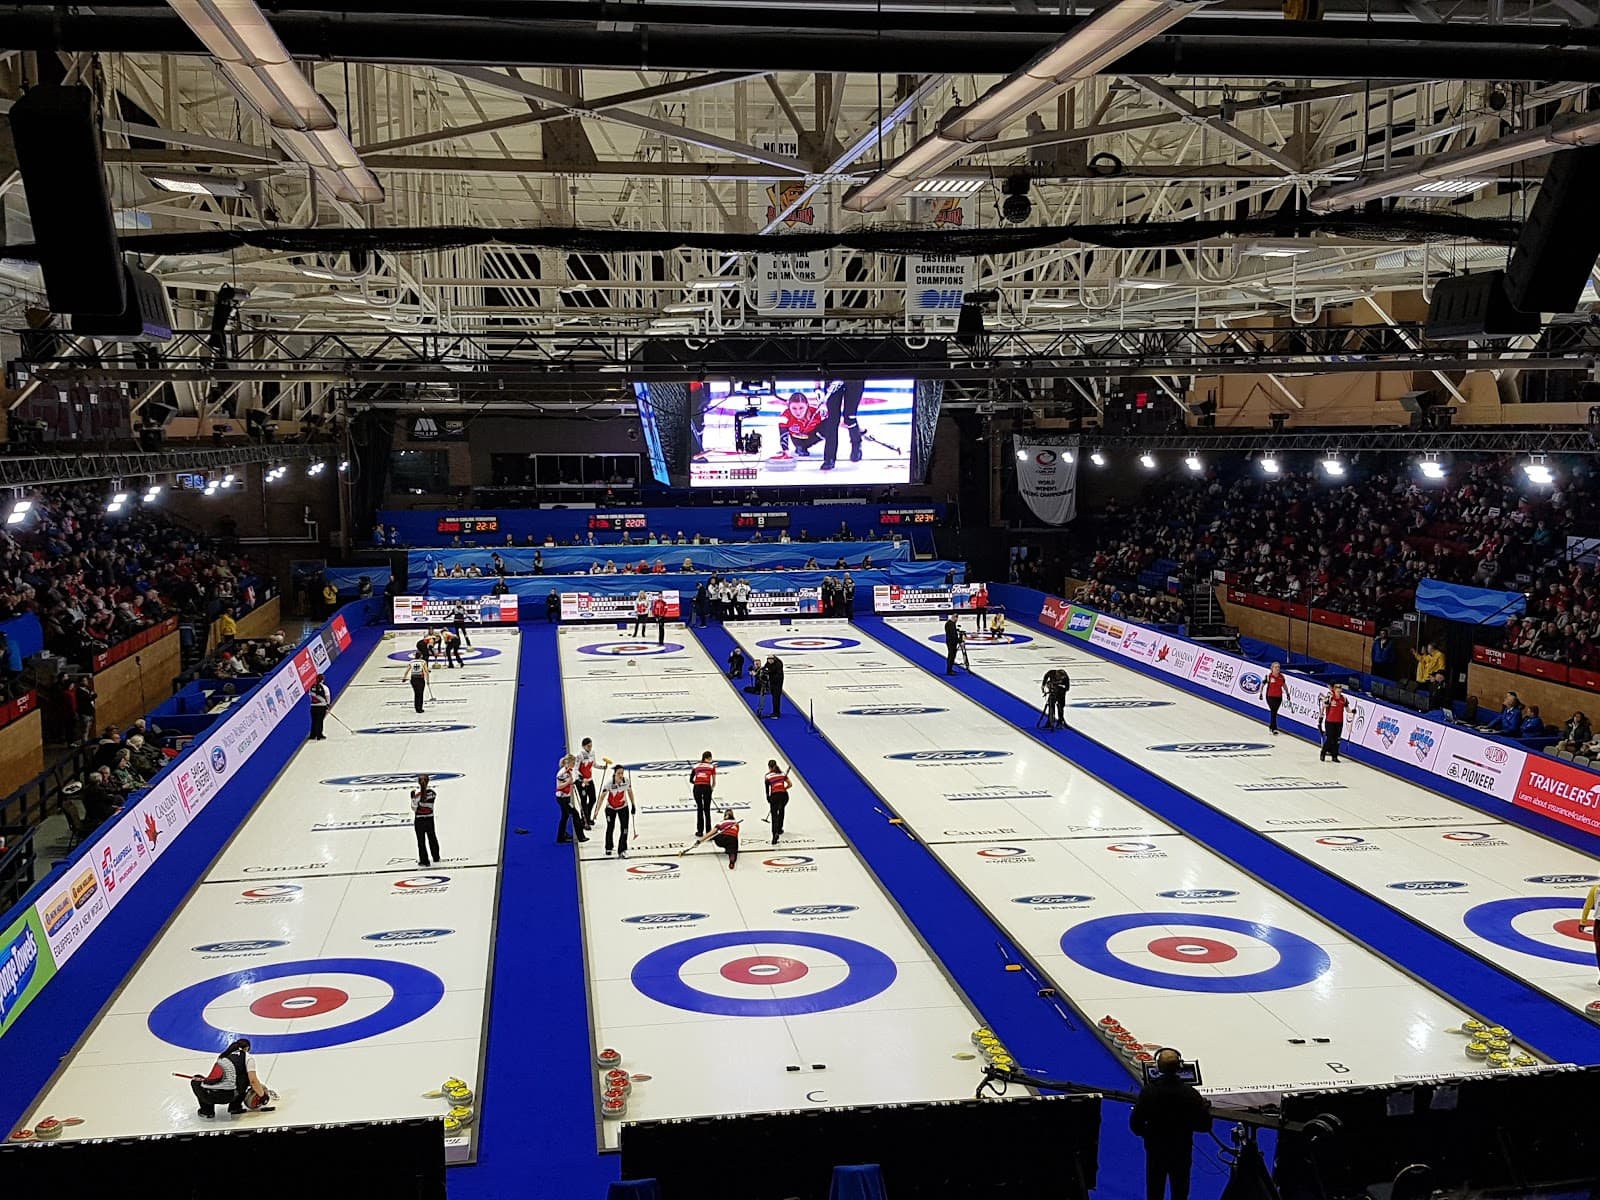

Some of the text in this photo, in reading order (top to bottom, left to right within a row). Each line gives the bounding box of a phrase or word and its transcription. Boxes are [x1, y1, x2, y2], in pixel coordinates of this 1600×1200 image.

[922, 253, 957, 263] EASTERN
[773, 260, 810, 269] DVIION
[915, 265, 965, 274] CONFERENCE
[916, 276, 964, 285] CHAMPIONS
[1215, 660, 1229, 671] SAVE
[1212, 669, 1234, 684] ENERGY
[1175, 743, 1249, 752] Ford
[911, 751, 988, 760] Ford
[940, 760, 1005, 768] Further
[1461, 767, 1495, 791] PIONEER
[1528, 771, 1594, 806] TRAVELERS
[943, 788, 1050, 799] NORTH BAY
[1532, 796, 1548, 809] about
[1094, 824, 1144, 832] Ontario
[1404, 881, 1453, 889] Ford
[1174, 890, 1223, 898] Ford
[1028, 895, 1078, 904] Ford
[791, 905, 842, 914] Ford
[642, 913, 695, 922] Ford
[385, 930, 444, 940] Ford
[210, 941, 272, 951] Ford
[1326, 1062, 1351, 1074] B
[806, 1089, 829, 1103] C
